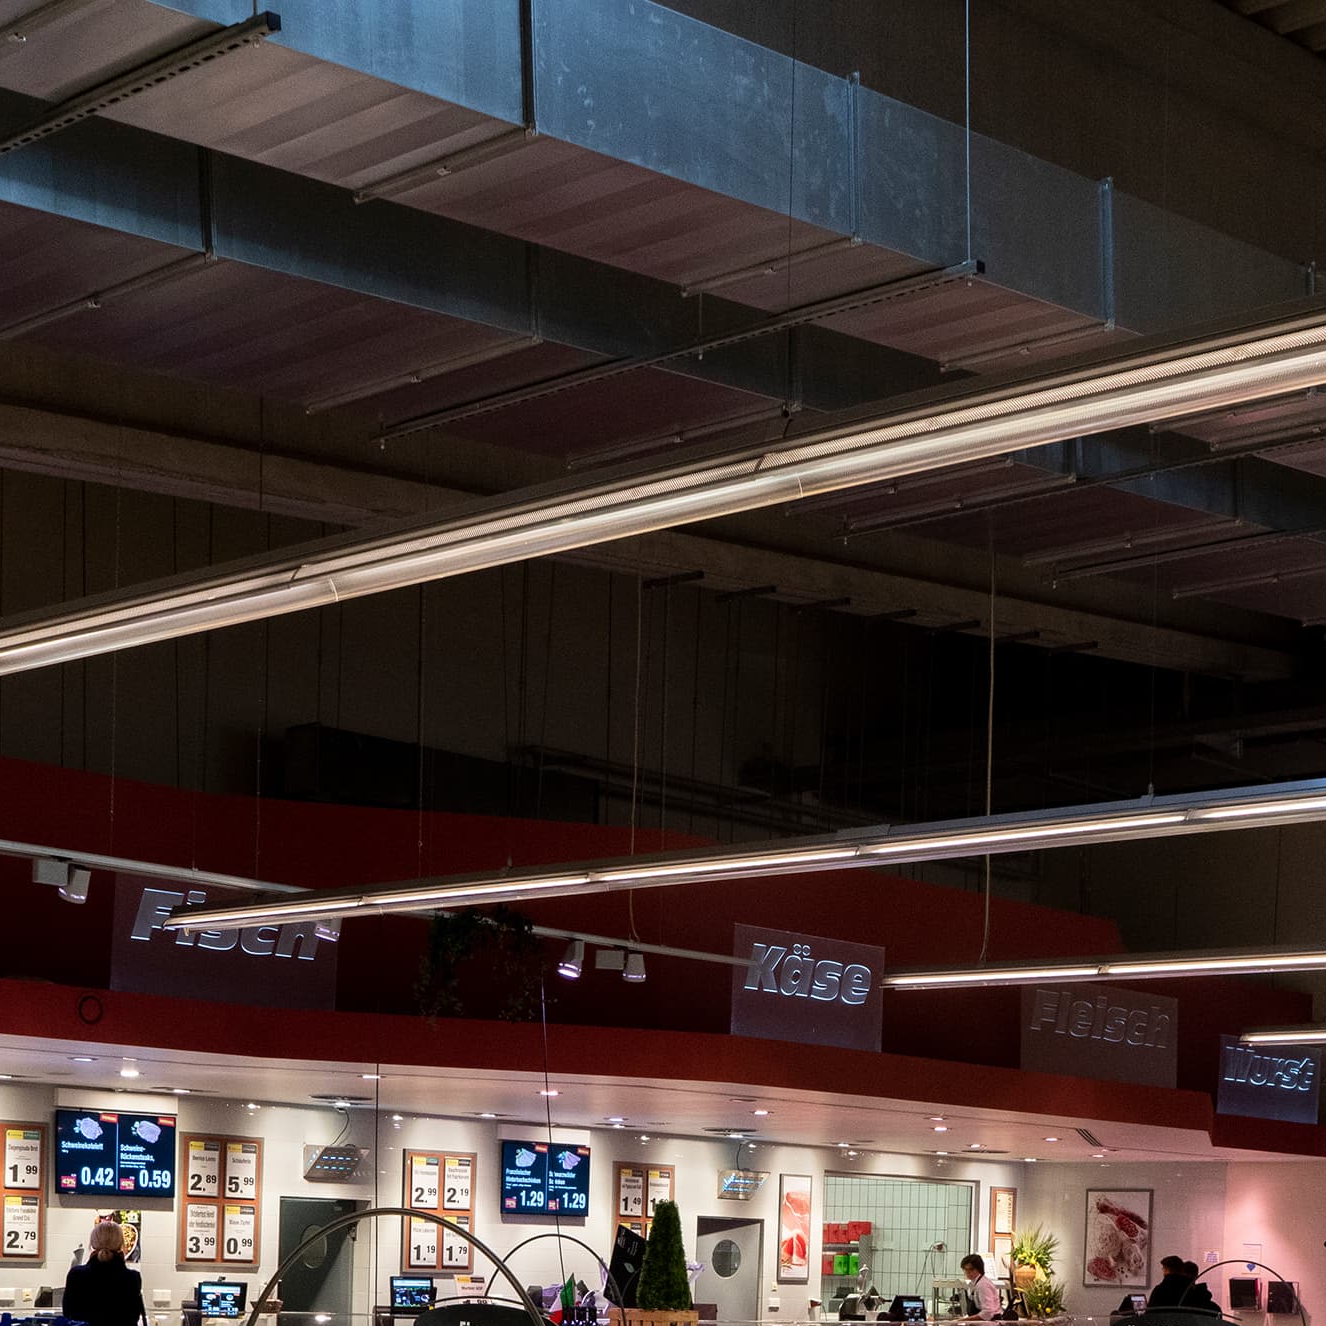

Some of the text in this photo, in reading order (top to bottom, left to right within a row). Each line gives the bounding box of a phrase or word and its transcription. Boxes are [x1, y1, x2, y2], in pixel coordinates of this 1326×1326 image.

[744, 942, 872, 1006] Käse
[1030, 988, 1171, 1050] Fleisch
[1224, 1045, 1314, 1092] Wurst
[9, 1164, 38, 1183] 1.99
[81, 1167, 114, 1186] 0.42
[139, 1170, 171, 1188] 0.59
[190, 1174, 216, 1191] 2.89
[228, 1176, 254, 1193] 5.99
[415, 1187, 436, 1203] 2.99
[447, 1188, 468, 1203] 2.19
[520, 1190, 544, 1206] 1.29
[563, 1192, 586, 1208] 1.29
[622, 1197, 641, 1211] 1.49
[6, 1230, 36, 1249] 2.79
[189, 1237, 215, 1254] 3.99
[227, 1238, 252, 1255] 0.99
[414, 1245, 435, 1261] 1.19
[446, 1246, 467, 1262] 1.79
